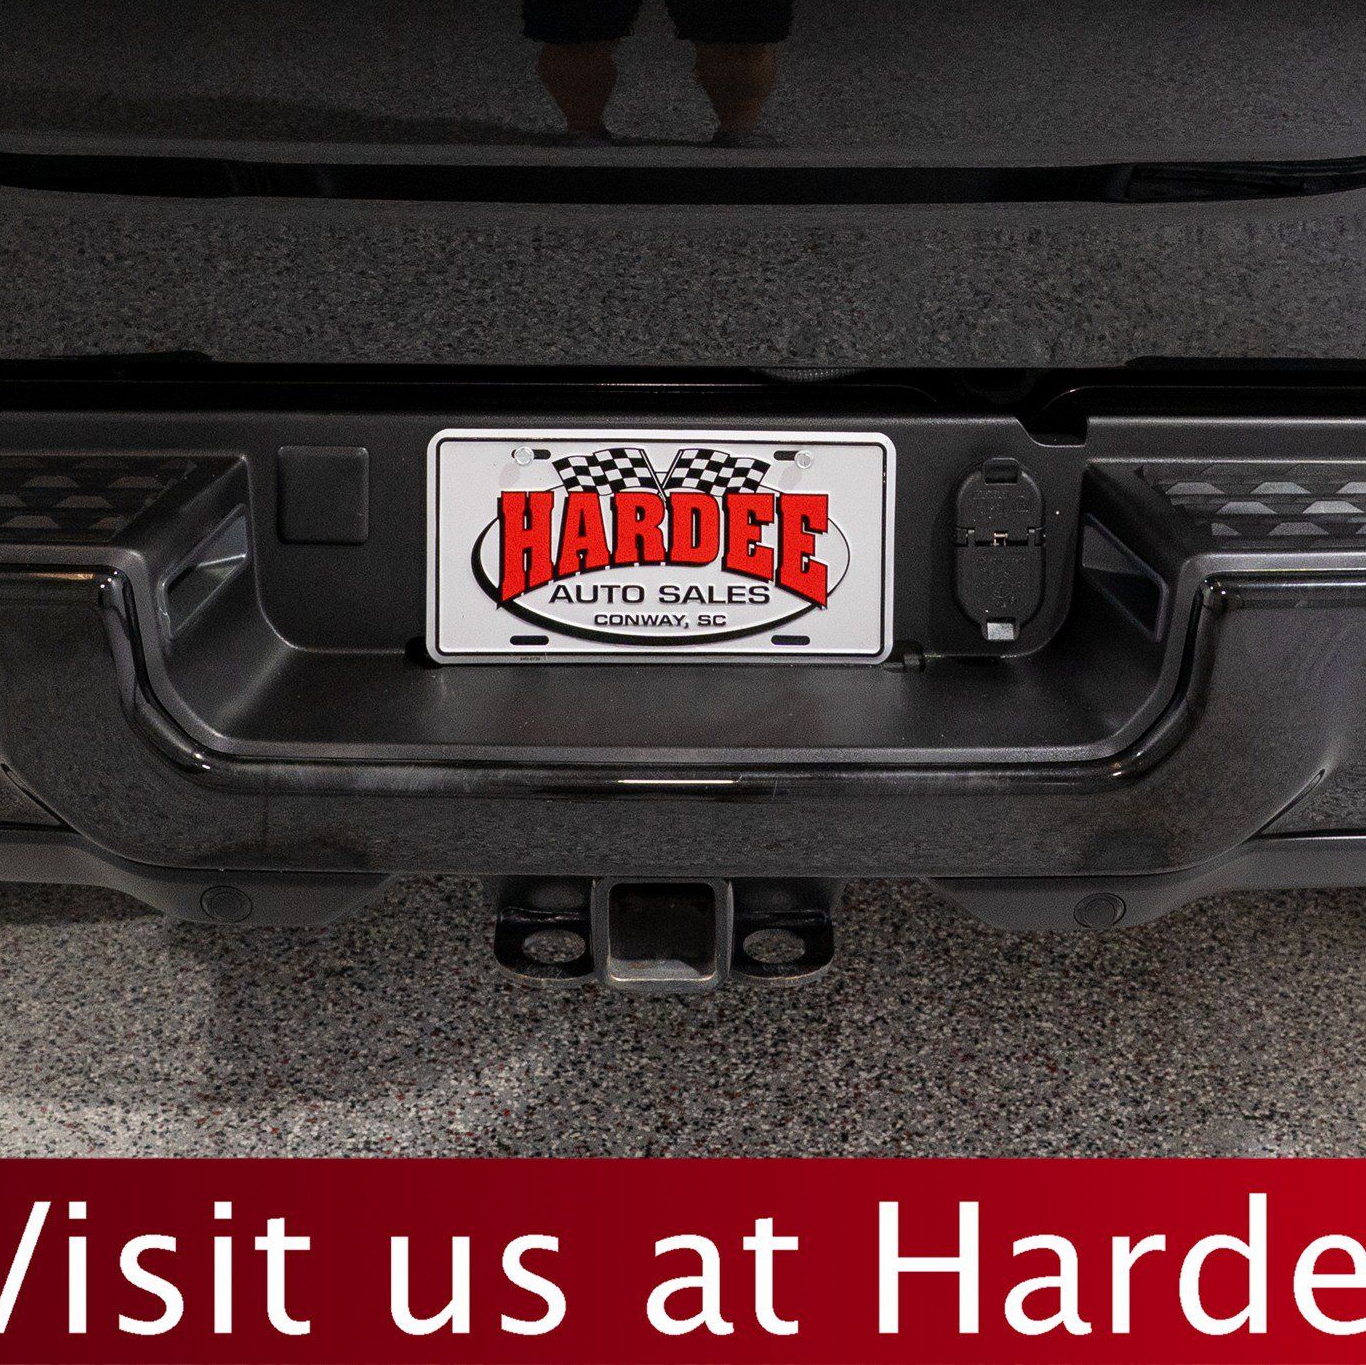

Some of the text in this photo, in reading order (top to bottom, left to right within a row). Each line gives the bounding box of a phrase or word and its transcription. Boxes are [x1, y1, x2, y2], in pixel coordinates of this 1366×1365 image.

[497, 490, 829, 610] HARDEE
[549, 584, 771, 606] AUTO SALES
[594, 614, 728, 630] CONWAY, SC
